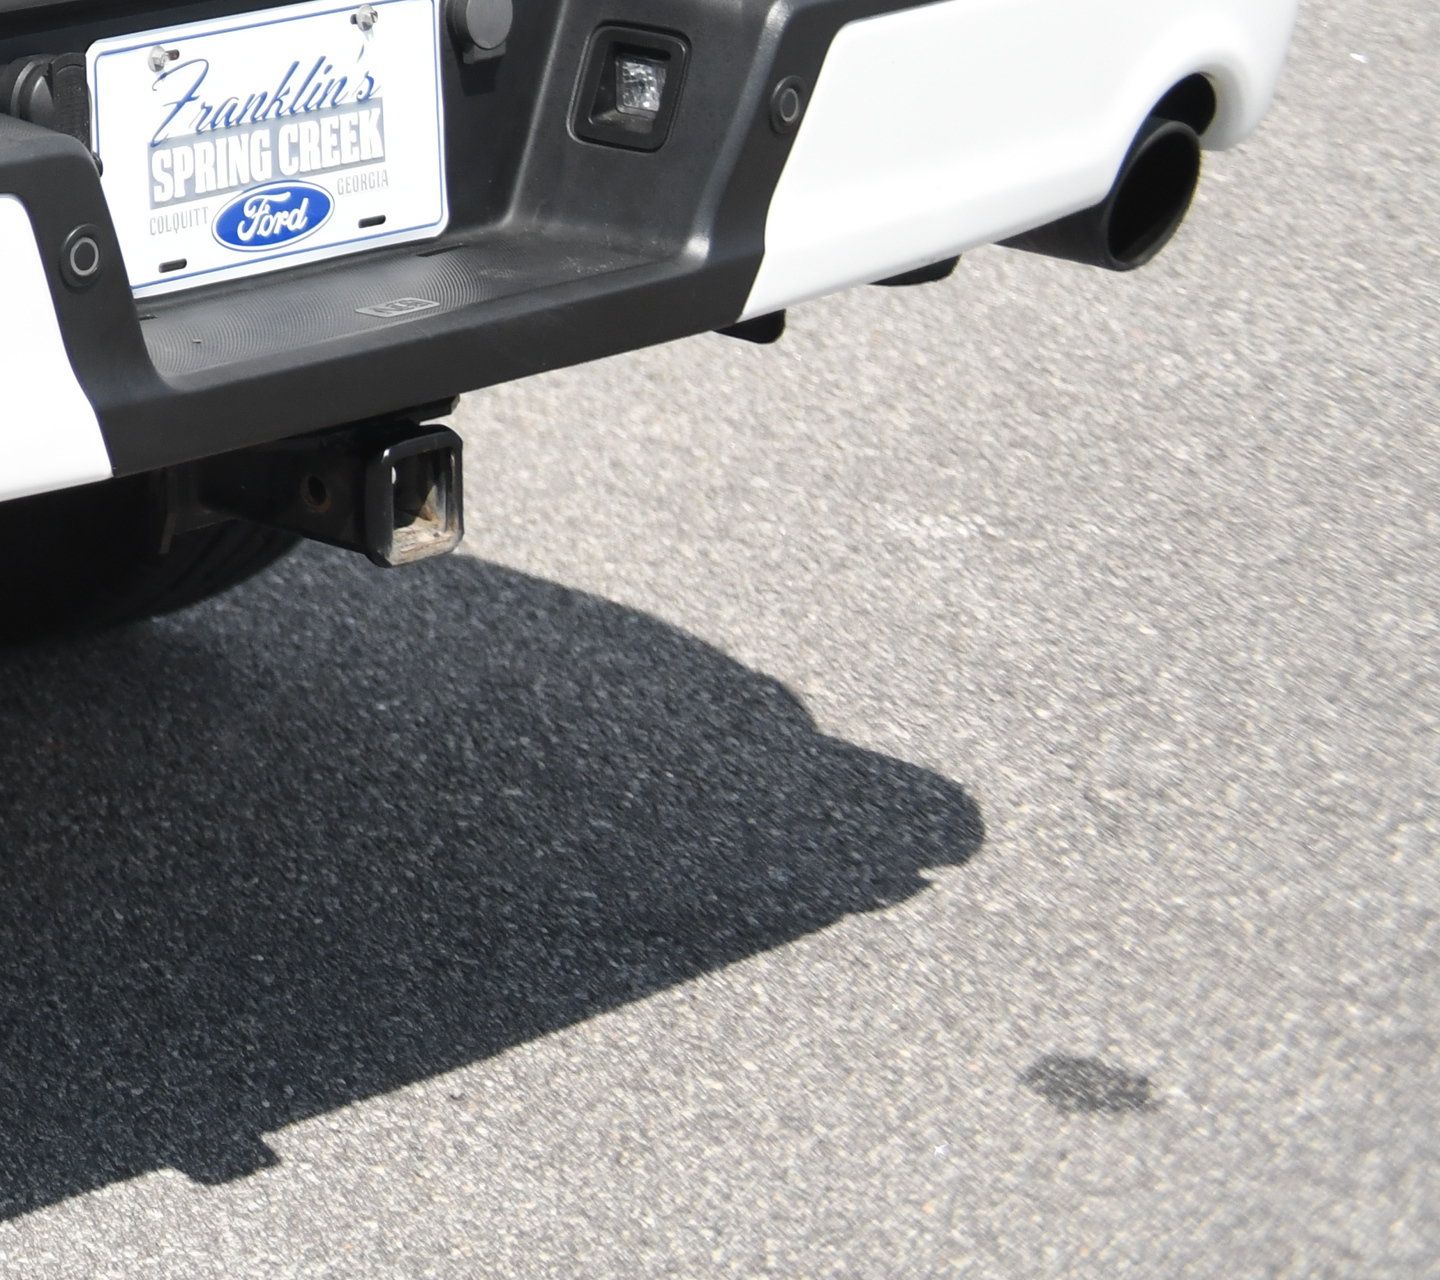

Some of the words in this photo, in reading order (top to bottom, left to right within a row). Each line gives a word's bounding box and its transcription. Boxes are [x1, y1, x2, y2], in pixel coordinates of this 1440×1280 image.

[150, 44, 380, 148] Franklin's
[149, 128, 272, 204] SPRING
[278, 107, 385, 178] CREEK
[336, 170, 390, 197] GEORGIA
[149, 206, 210, 237] COLQUITT
[237, 191, 309, 243] Ford
